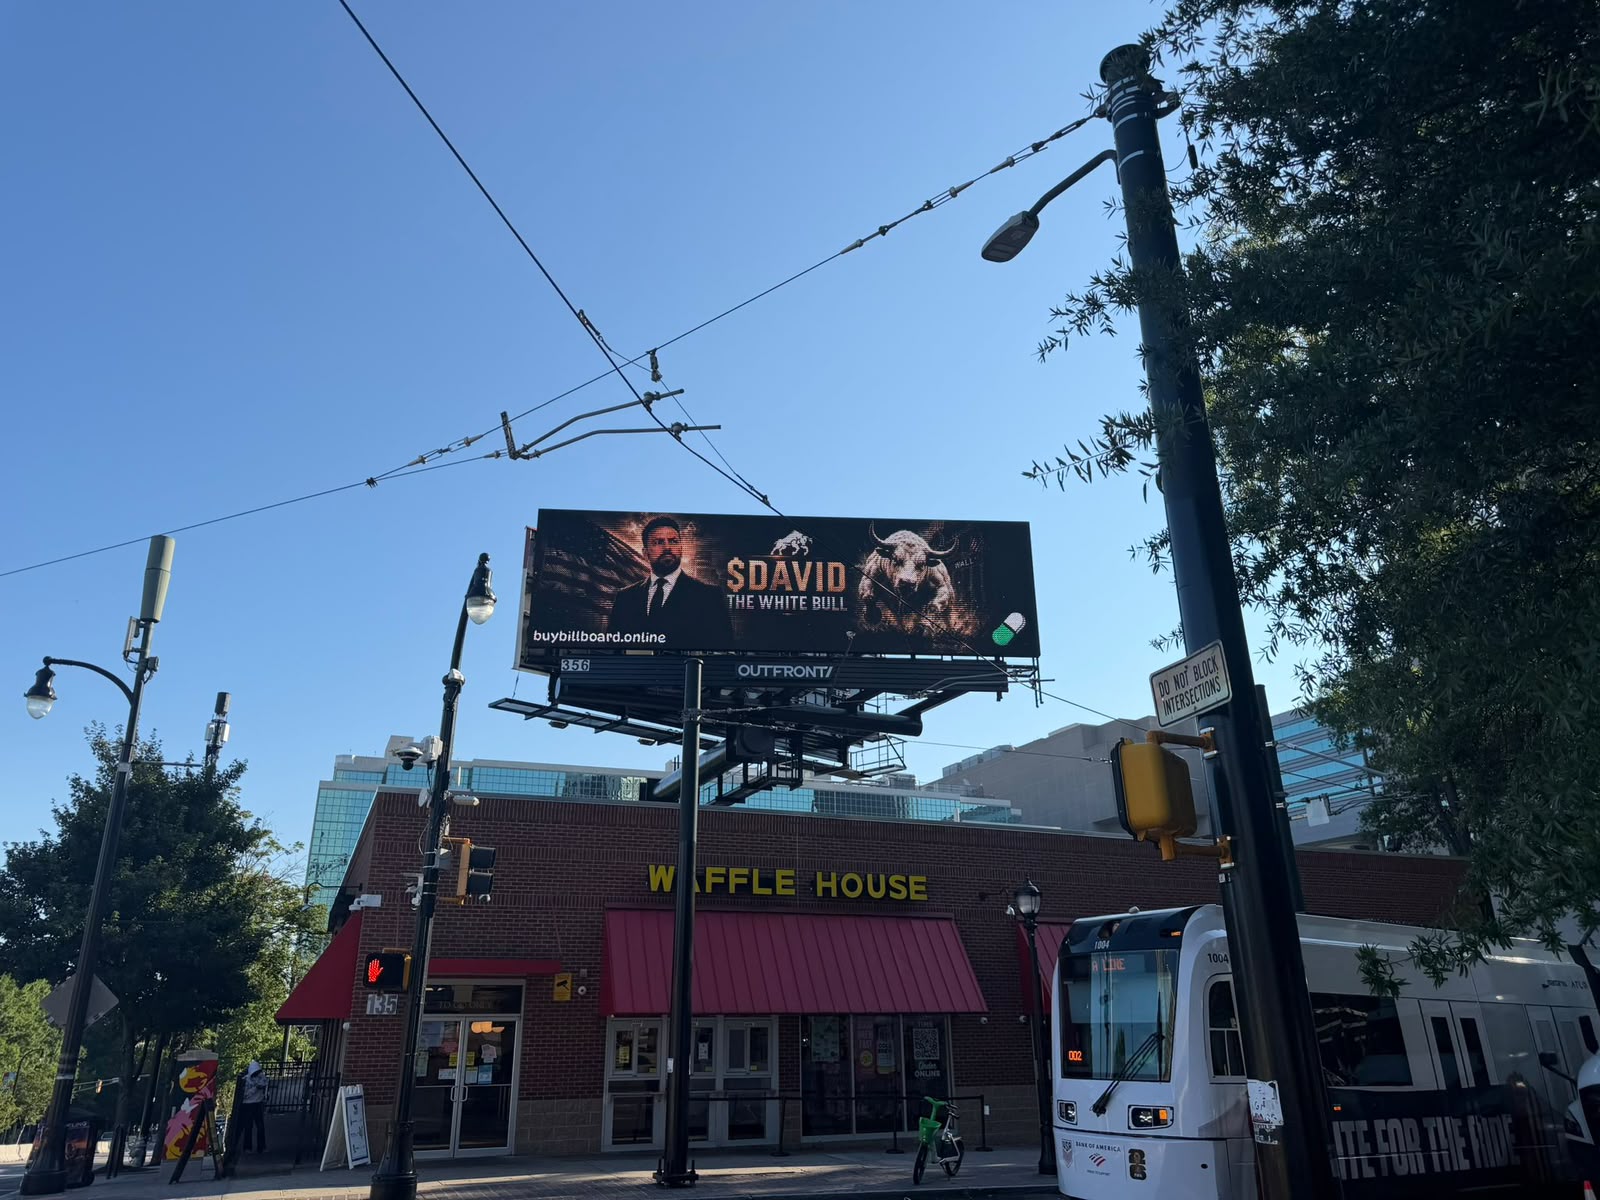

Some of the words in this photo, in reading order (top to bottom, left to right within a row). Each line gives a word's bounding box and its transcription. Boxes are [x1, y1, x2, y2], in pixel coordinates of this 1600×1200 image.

[727, 557, 846, 592] $DAVID
[727, 594, 755, 609] THE
[759, 595, 808, 610] WHITE
[812, 596, 848, 611] BULL
[533, 630, 667, 643] buybillboard.online
[562, 660, 588, 670] 356
[1158, 679, 1170, 698] DO
[1173, 667, 1190, 691] NOT
[1193, 655, 1219, 681] BLOCK
[1162, 675, 1221, 717] INTERSECTIONS
[649, 864, 796, 895] WFFLE
[816, 871, 928, 900] HOUSE
[1094, 940, 1111, 950] 1004
[1102, 957, 1126, 971] LINE
[1207, 952, 1229, 964] 1004
[368, 994, 397, 1014] 135
[1096, 1144, 1121, 1152] AMERICA
[1374, 1118, 1425, 1177] FOR
[1422, 1116, 1470, 1172] THE
[1467, 1114, 1520, 1169] RIDE
